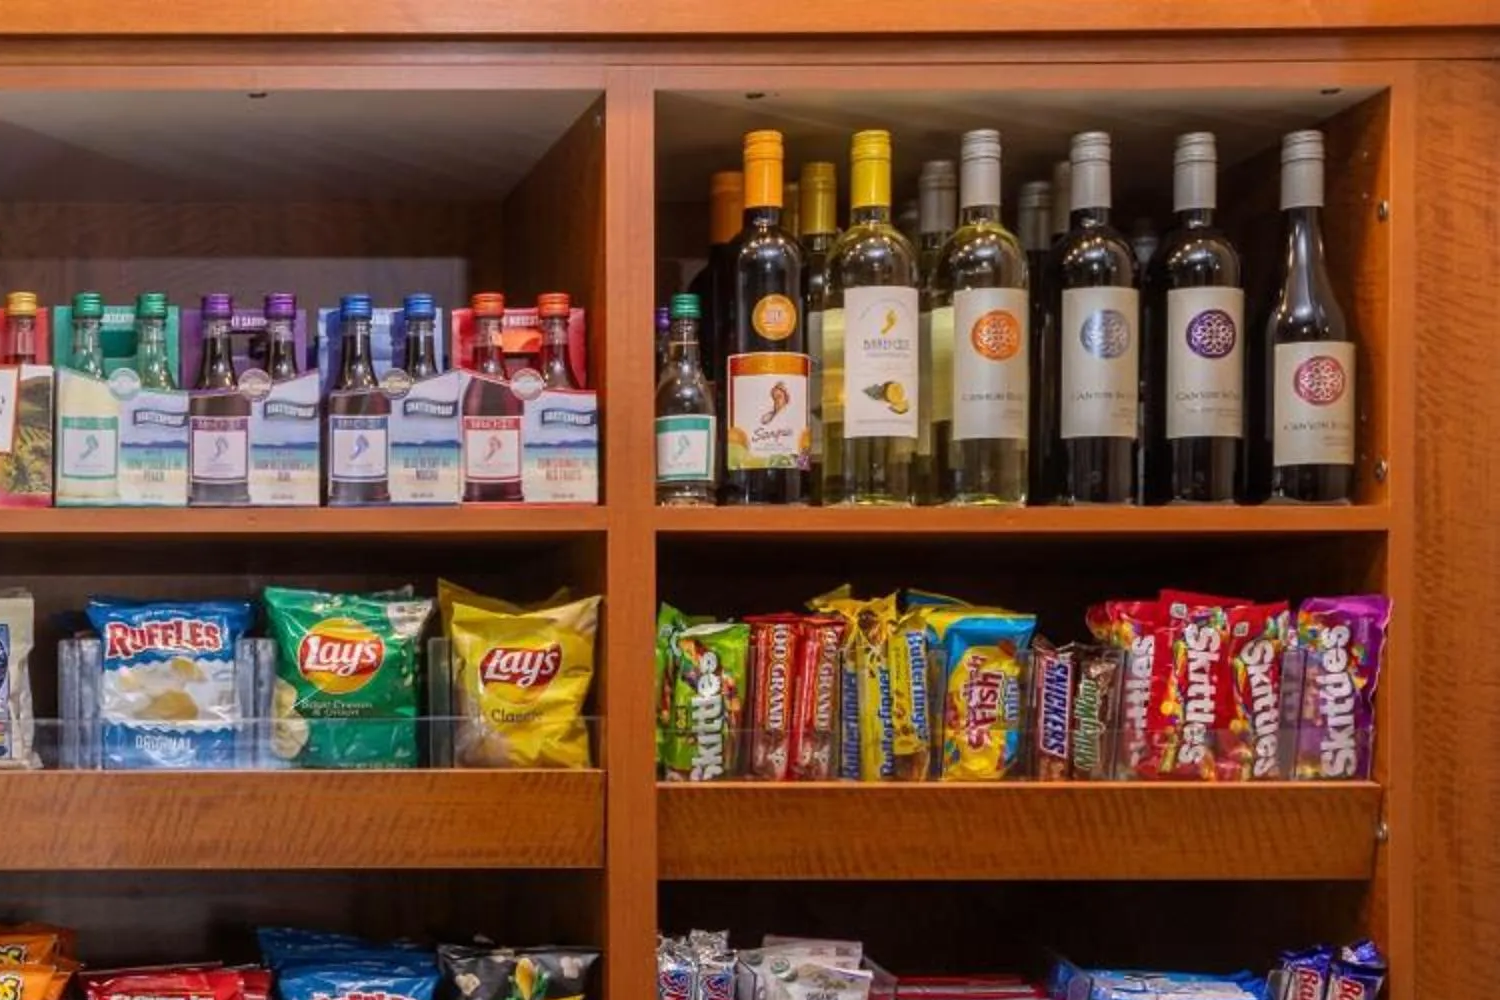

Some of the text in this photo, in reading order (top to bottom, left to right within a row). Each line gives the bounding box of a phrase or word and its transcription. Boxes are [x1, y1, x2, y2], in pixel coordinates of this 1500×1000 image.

[106, 619, 221, 658] RUFFLES
[1178, 622, 1221, 764] Skittles
[1316, 625, 1357, 777] Skittles
[135, 734, 192, 750] ORIGINAL
[690, 651, 724, 782] Skittles
[1043, 659, 1069, 755] SNICKERS
[1241, 639, 1279, 776] Skittles
